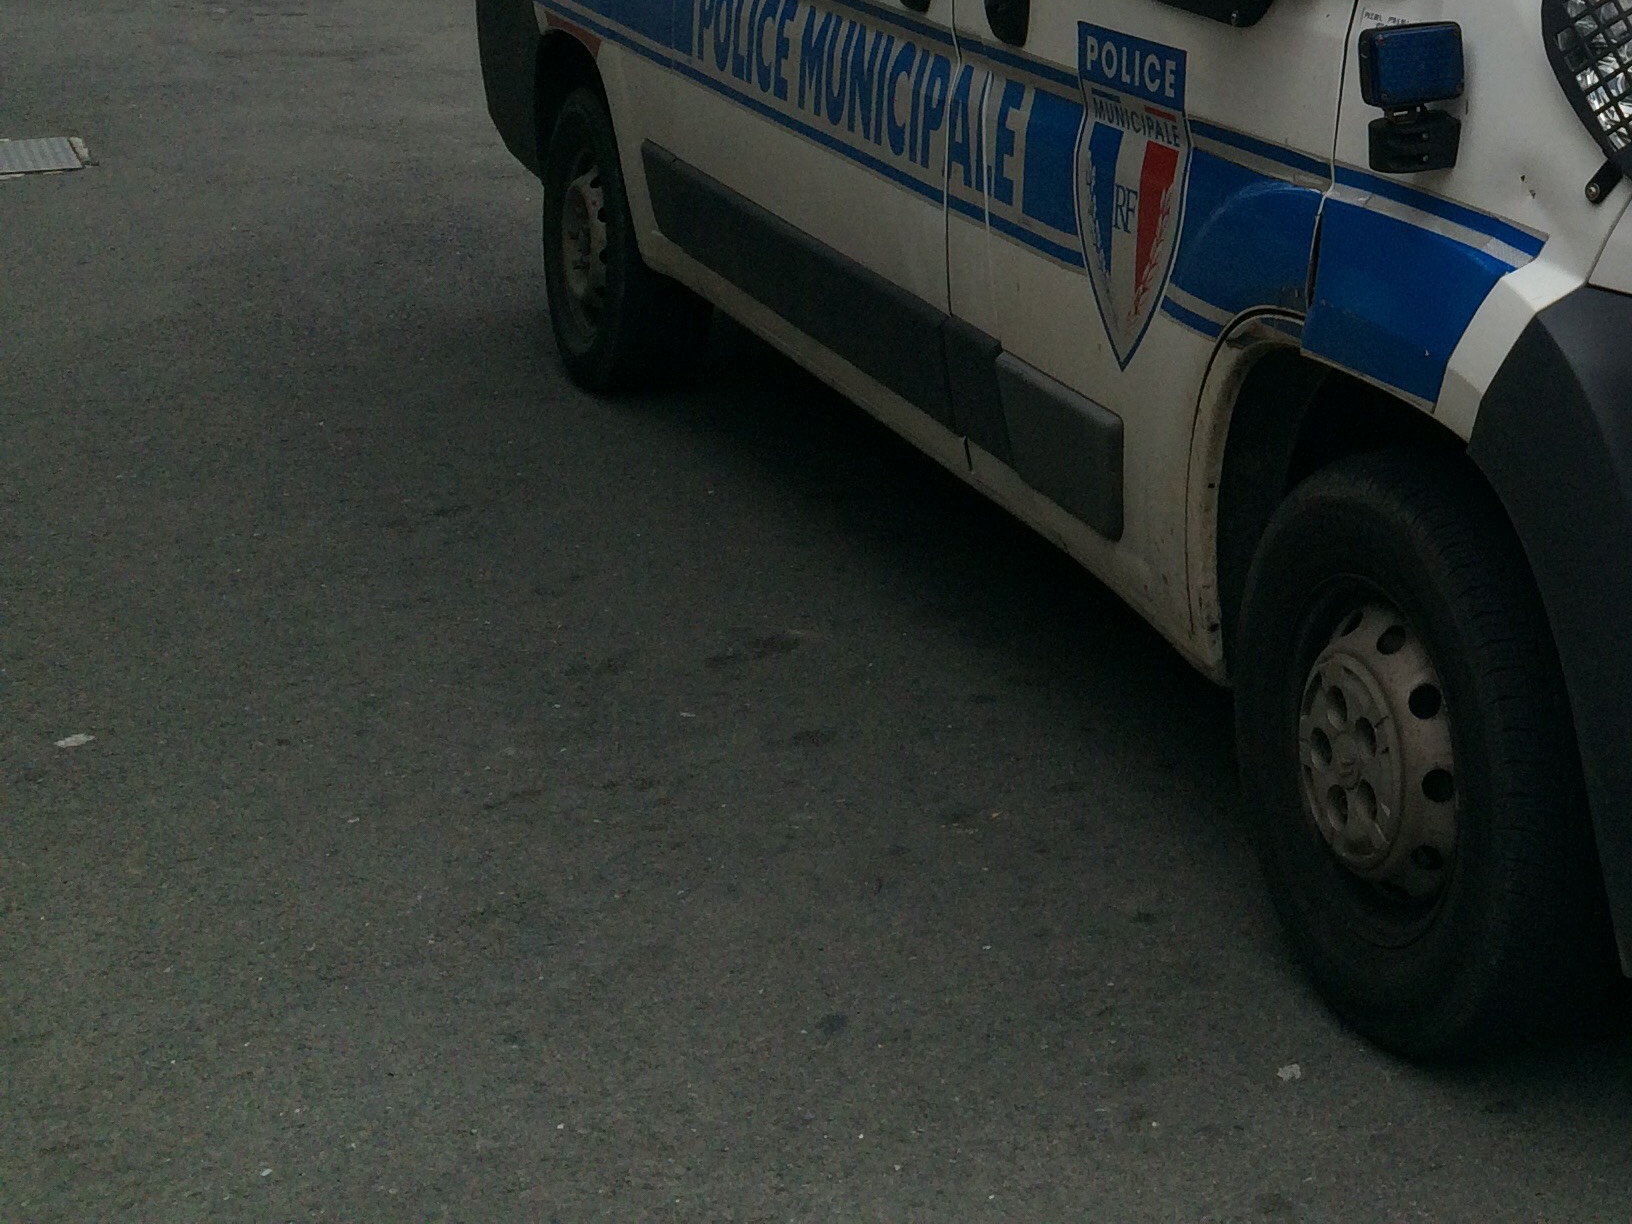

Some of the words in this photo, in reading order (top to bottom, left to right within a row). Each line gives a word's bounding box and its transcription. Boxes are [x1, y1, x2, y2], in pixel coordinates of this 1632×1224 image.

[1086, 35, 1177, 98] POLICE
[798, 5, 1026, 206] MUNICIPALE
[1093, 97, 1181, 147] MUNICIPALE
[1113, 183, 1138, 234] RF
